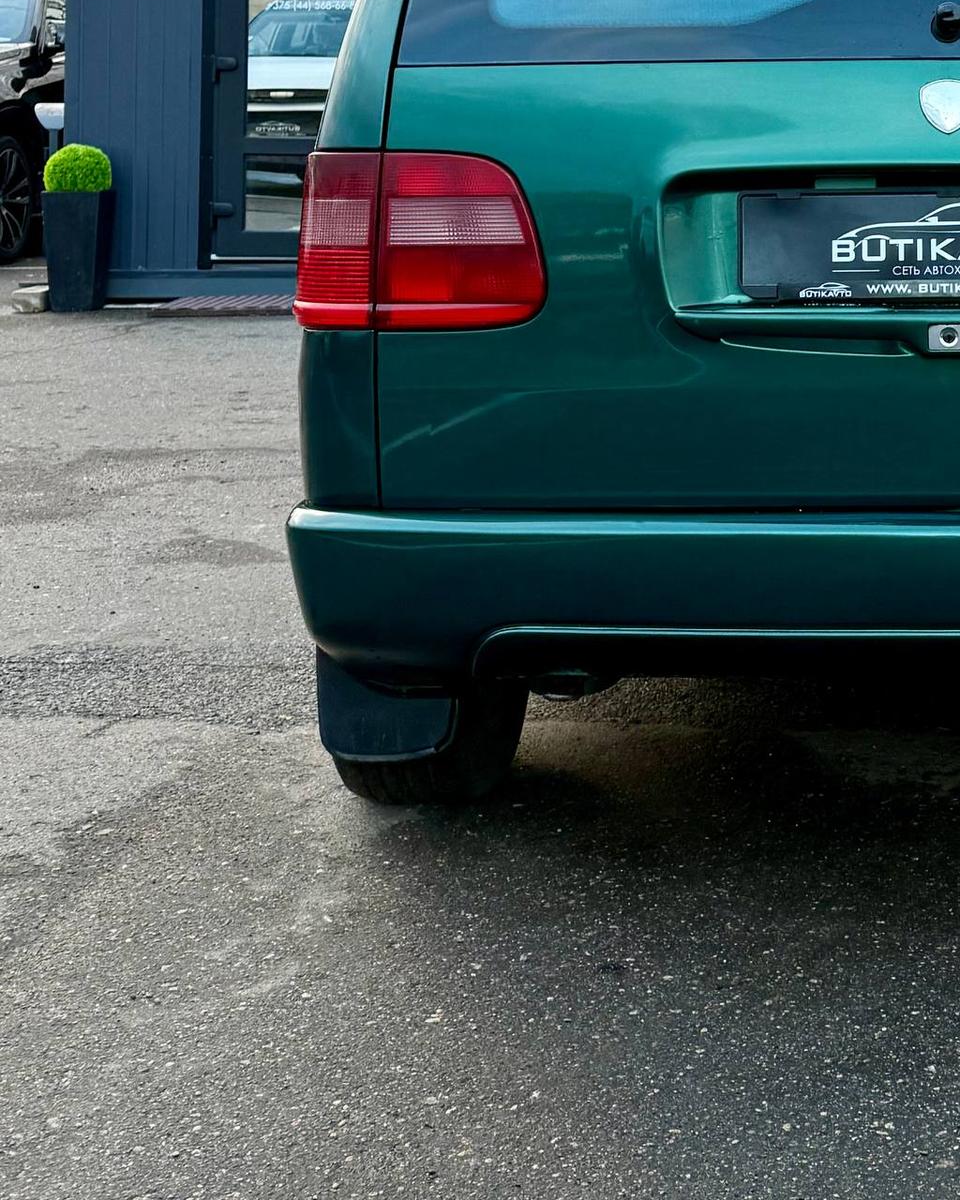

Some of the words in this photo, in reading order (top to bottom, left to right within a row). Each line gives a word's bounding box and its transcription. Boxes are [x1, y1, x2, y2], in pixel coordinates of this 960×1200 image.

[293, 0, 311, 12] (44)
[892, 265, 921, 276] СЕТЬ
[799, 290, 852, 298] BUTIKAVTO
[866, 283, 912, 294] WWW.
